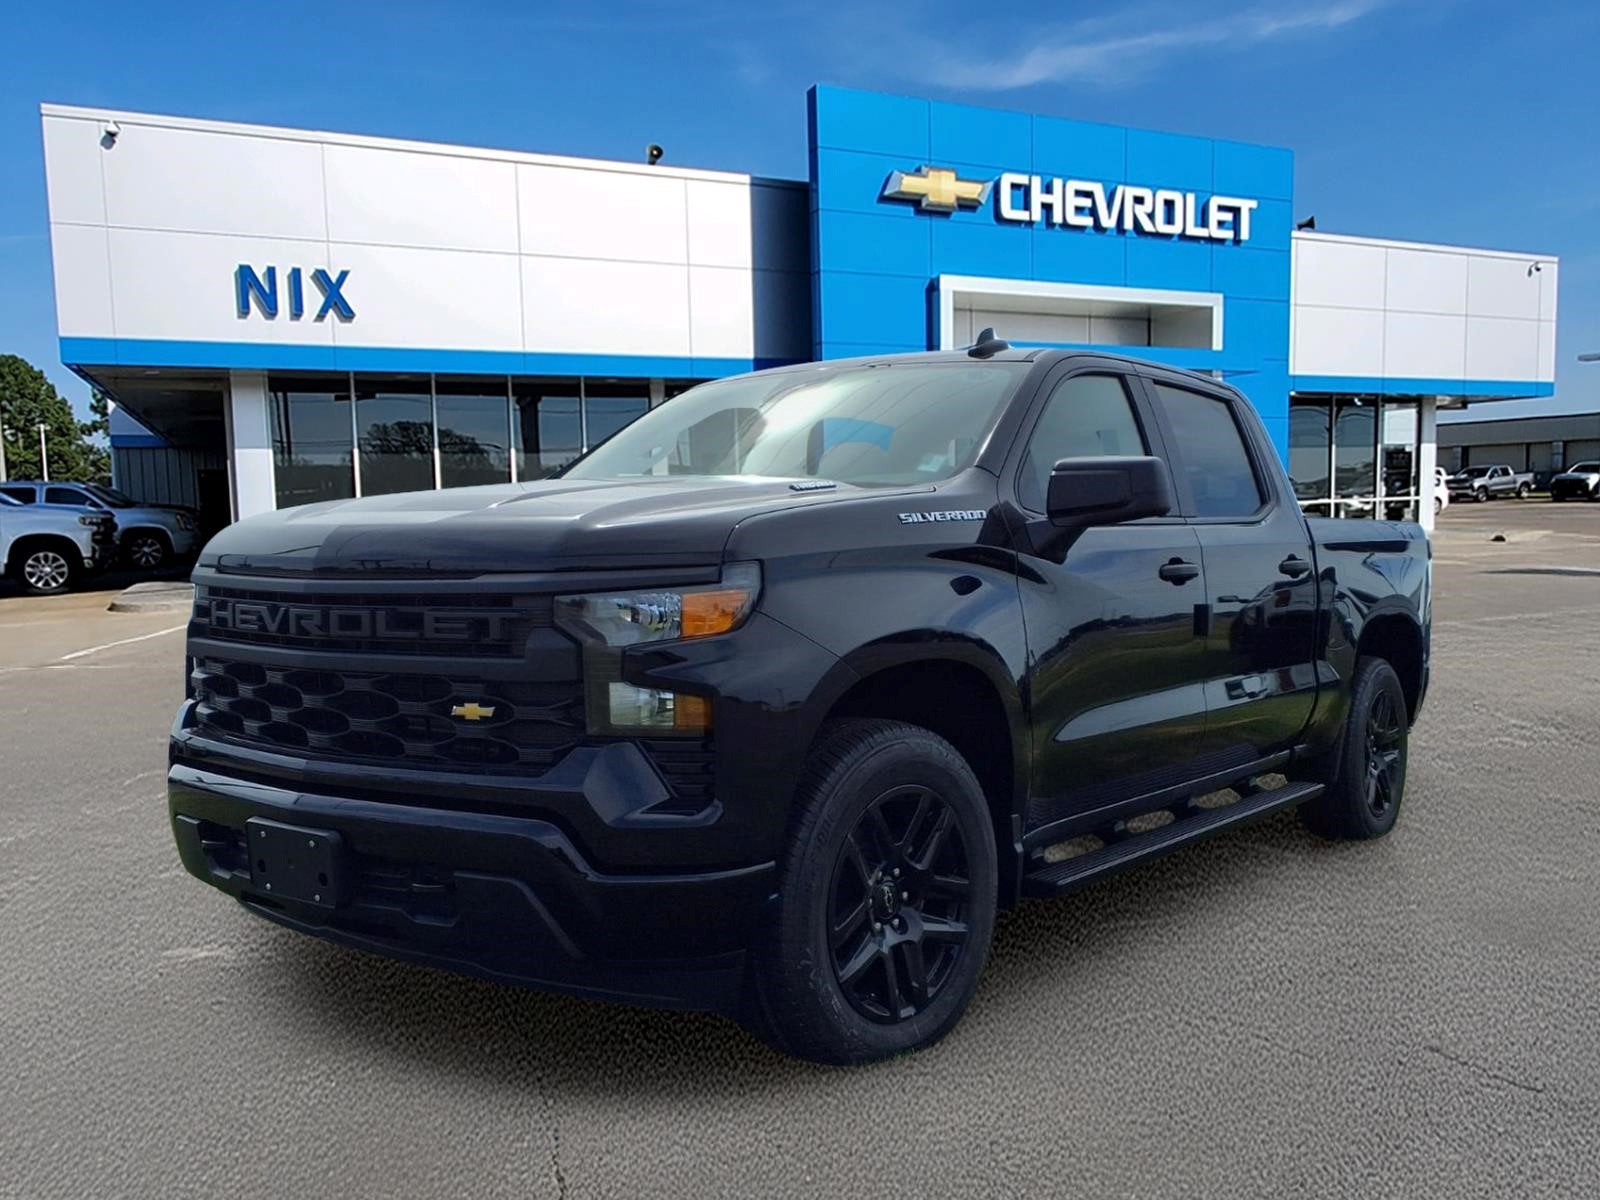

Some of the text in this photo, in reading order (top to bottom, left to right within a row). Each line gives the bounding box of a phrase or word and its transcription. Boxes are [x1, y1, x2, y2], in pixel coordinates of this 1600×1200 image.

[999, 172, 1258, 241] CHEVROLET
[234, 263, 356, 323] NIX
[899, 509, 987, 525] SILVERADO
